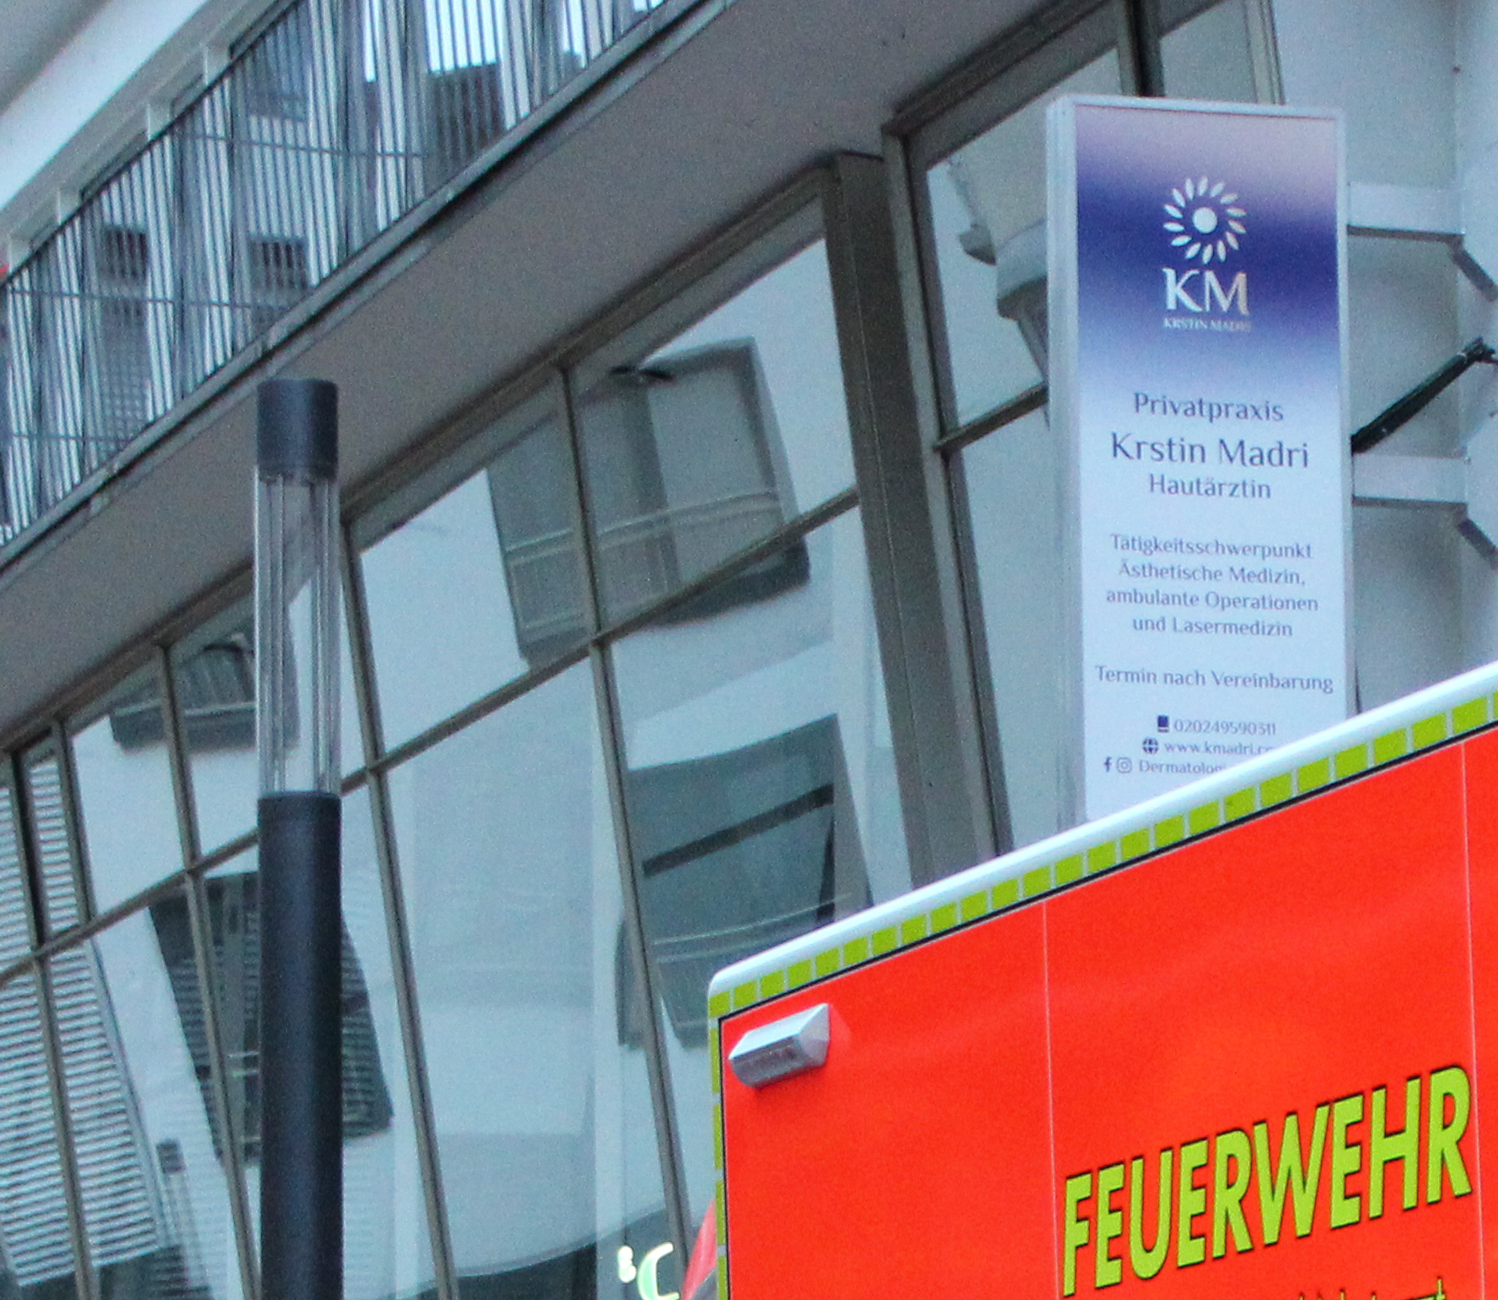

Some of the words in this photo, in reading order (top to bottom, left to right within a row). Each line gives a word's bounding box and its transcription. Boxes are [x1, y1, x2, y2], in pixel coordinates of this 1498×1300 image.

[1162, 267, 1250, 315] KM
[1133, 391, 1284, 423] Privatpraxis
[1111, 431, 1206, 464] Krstin
[1218, 438, 1309, 468] Madri
[1149, 472, 1272, 499] Hautärztin
[1118, 558, 1223, 582] Ästhetische
[1106, 588, 1200, 606] ambulante
[1205, 591, 1319, 611] Operationen
[1132, 616, 1166, 632] und
[1173, 617, 1293, 637] Lasermedizin
[1095, 665, 1158, 684] Termin
[1163, 669, 1206, 687] nach
[1211, 670, 1334, 694] Vereinbarung
[1062, 1063, 1473, 1299] FEUERWEHR
